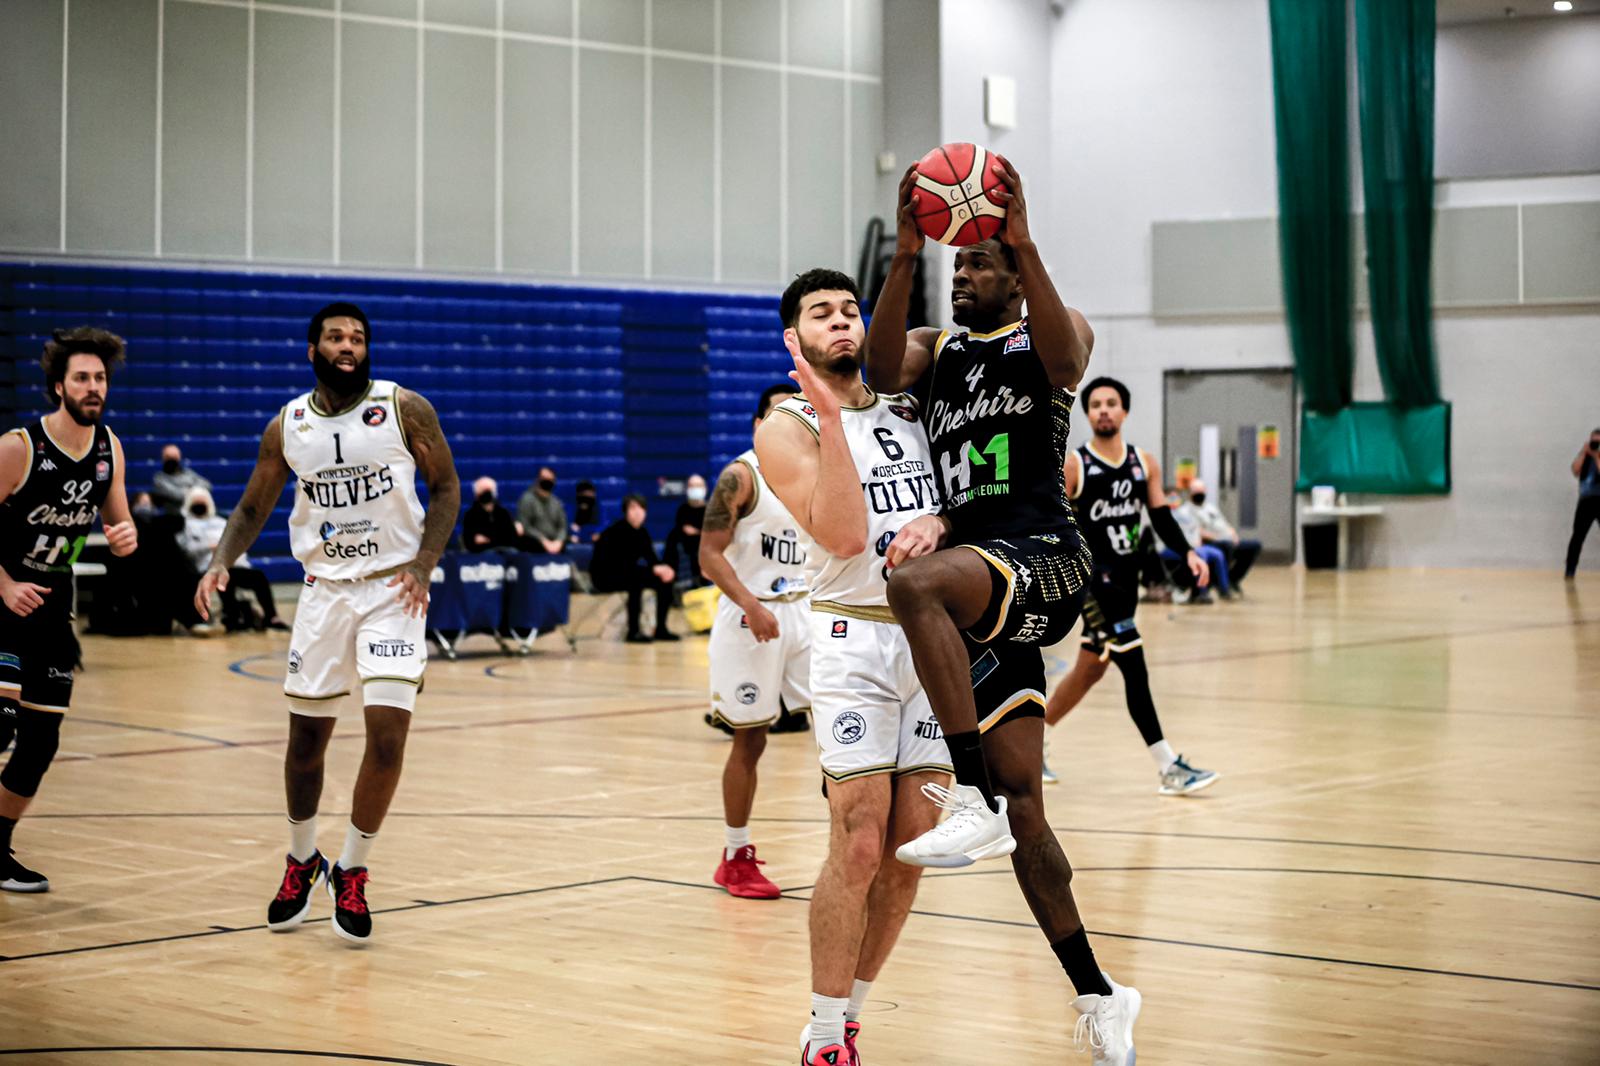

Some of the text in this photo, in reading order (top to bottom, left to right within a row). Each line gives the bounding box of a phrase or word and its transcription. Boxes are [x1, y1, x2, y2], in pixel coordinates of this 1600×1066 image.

[965, 363, 986, 392] 4
[929, 385, 1034, 443] Cheshire
[333, 433, 345, 464] 1
[872, 427, 904, 462] 6
[315, 464, 369, 480] WORCESTER
[871, 460, 925, 478] WORCESTER
[61, 480, 93, 505] 32
[301, 464, 394, 508] WOLVES
[861, 473, 941, 514] OLVE
[1111, 479, 1133, 499] 10
[323, 539, 379, 559] Gtech
[368, 642, 415, 658] WOLVES
[914, 720, 944, 741] WOL
